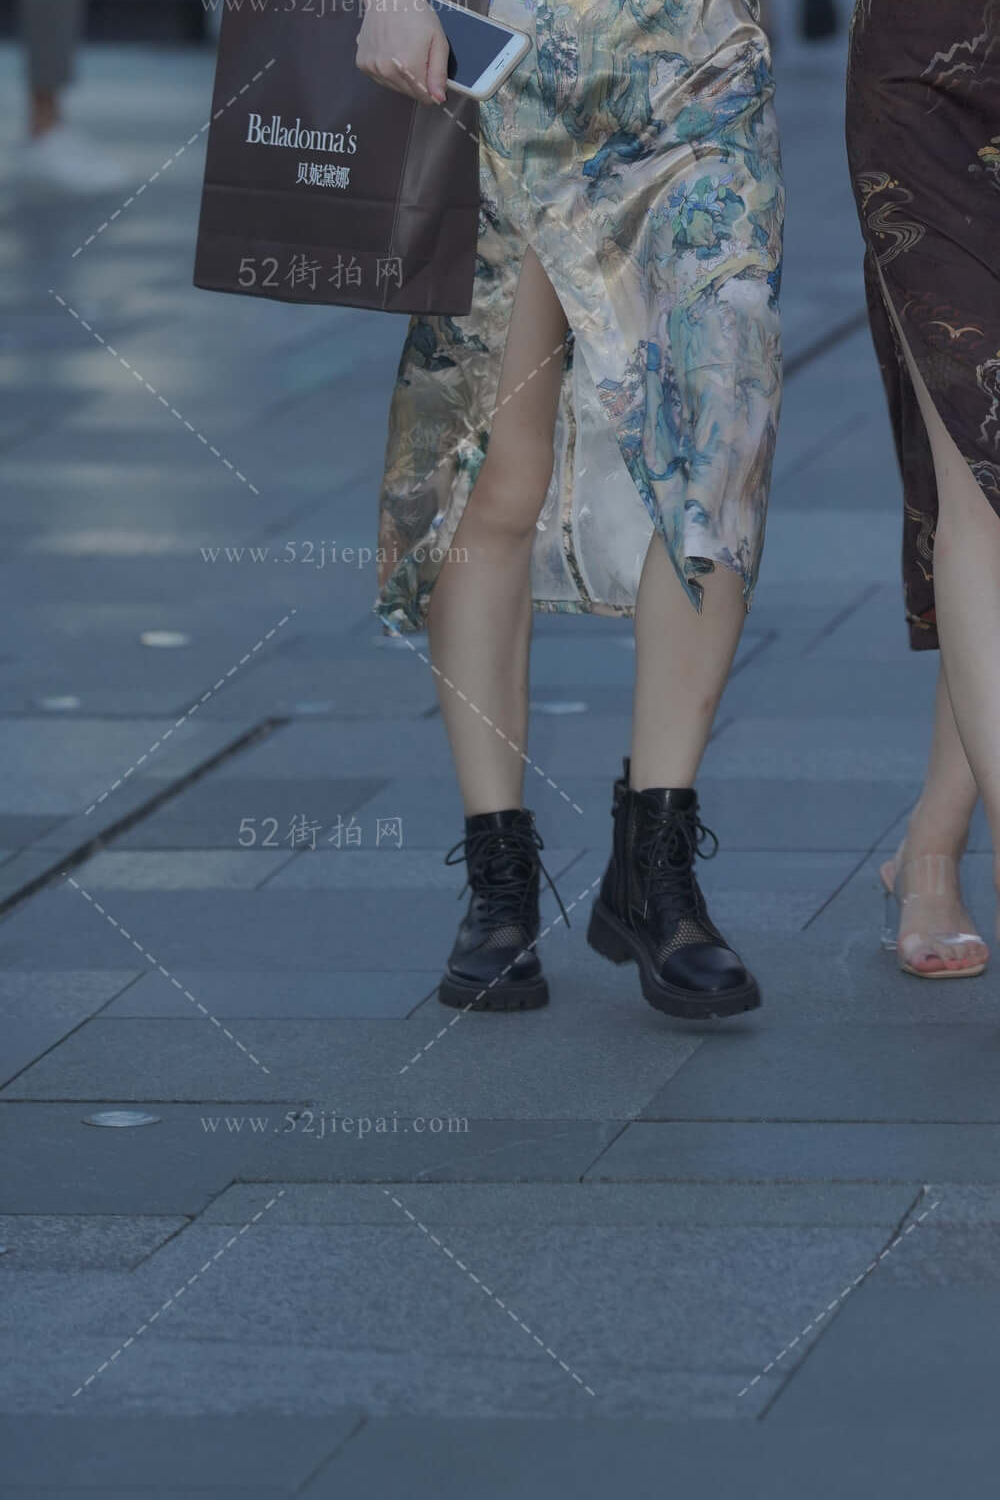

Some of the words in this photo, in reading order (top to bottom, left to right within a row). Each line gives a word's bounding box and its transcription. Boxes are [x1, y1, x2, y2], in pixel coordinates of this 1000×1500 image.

[246, 113, 357, 154] Belladonna's
[296, 162, 350, 189] 贝妮黛娜
